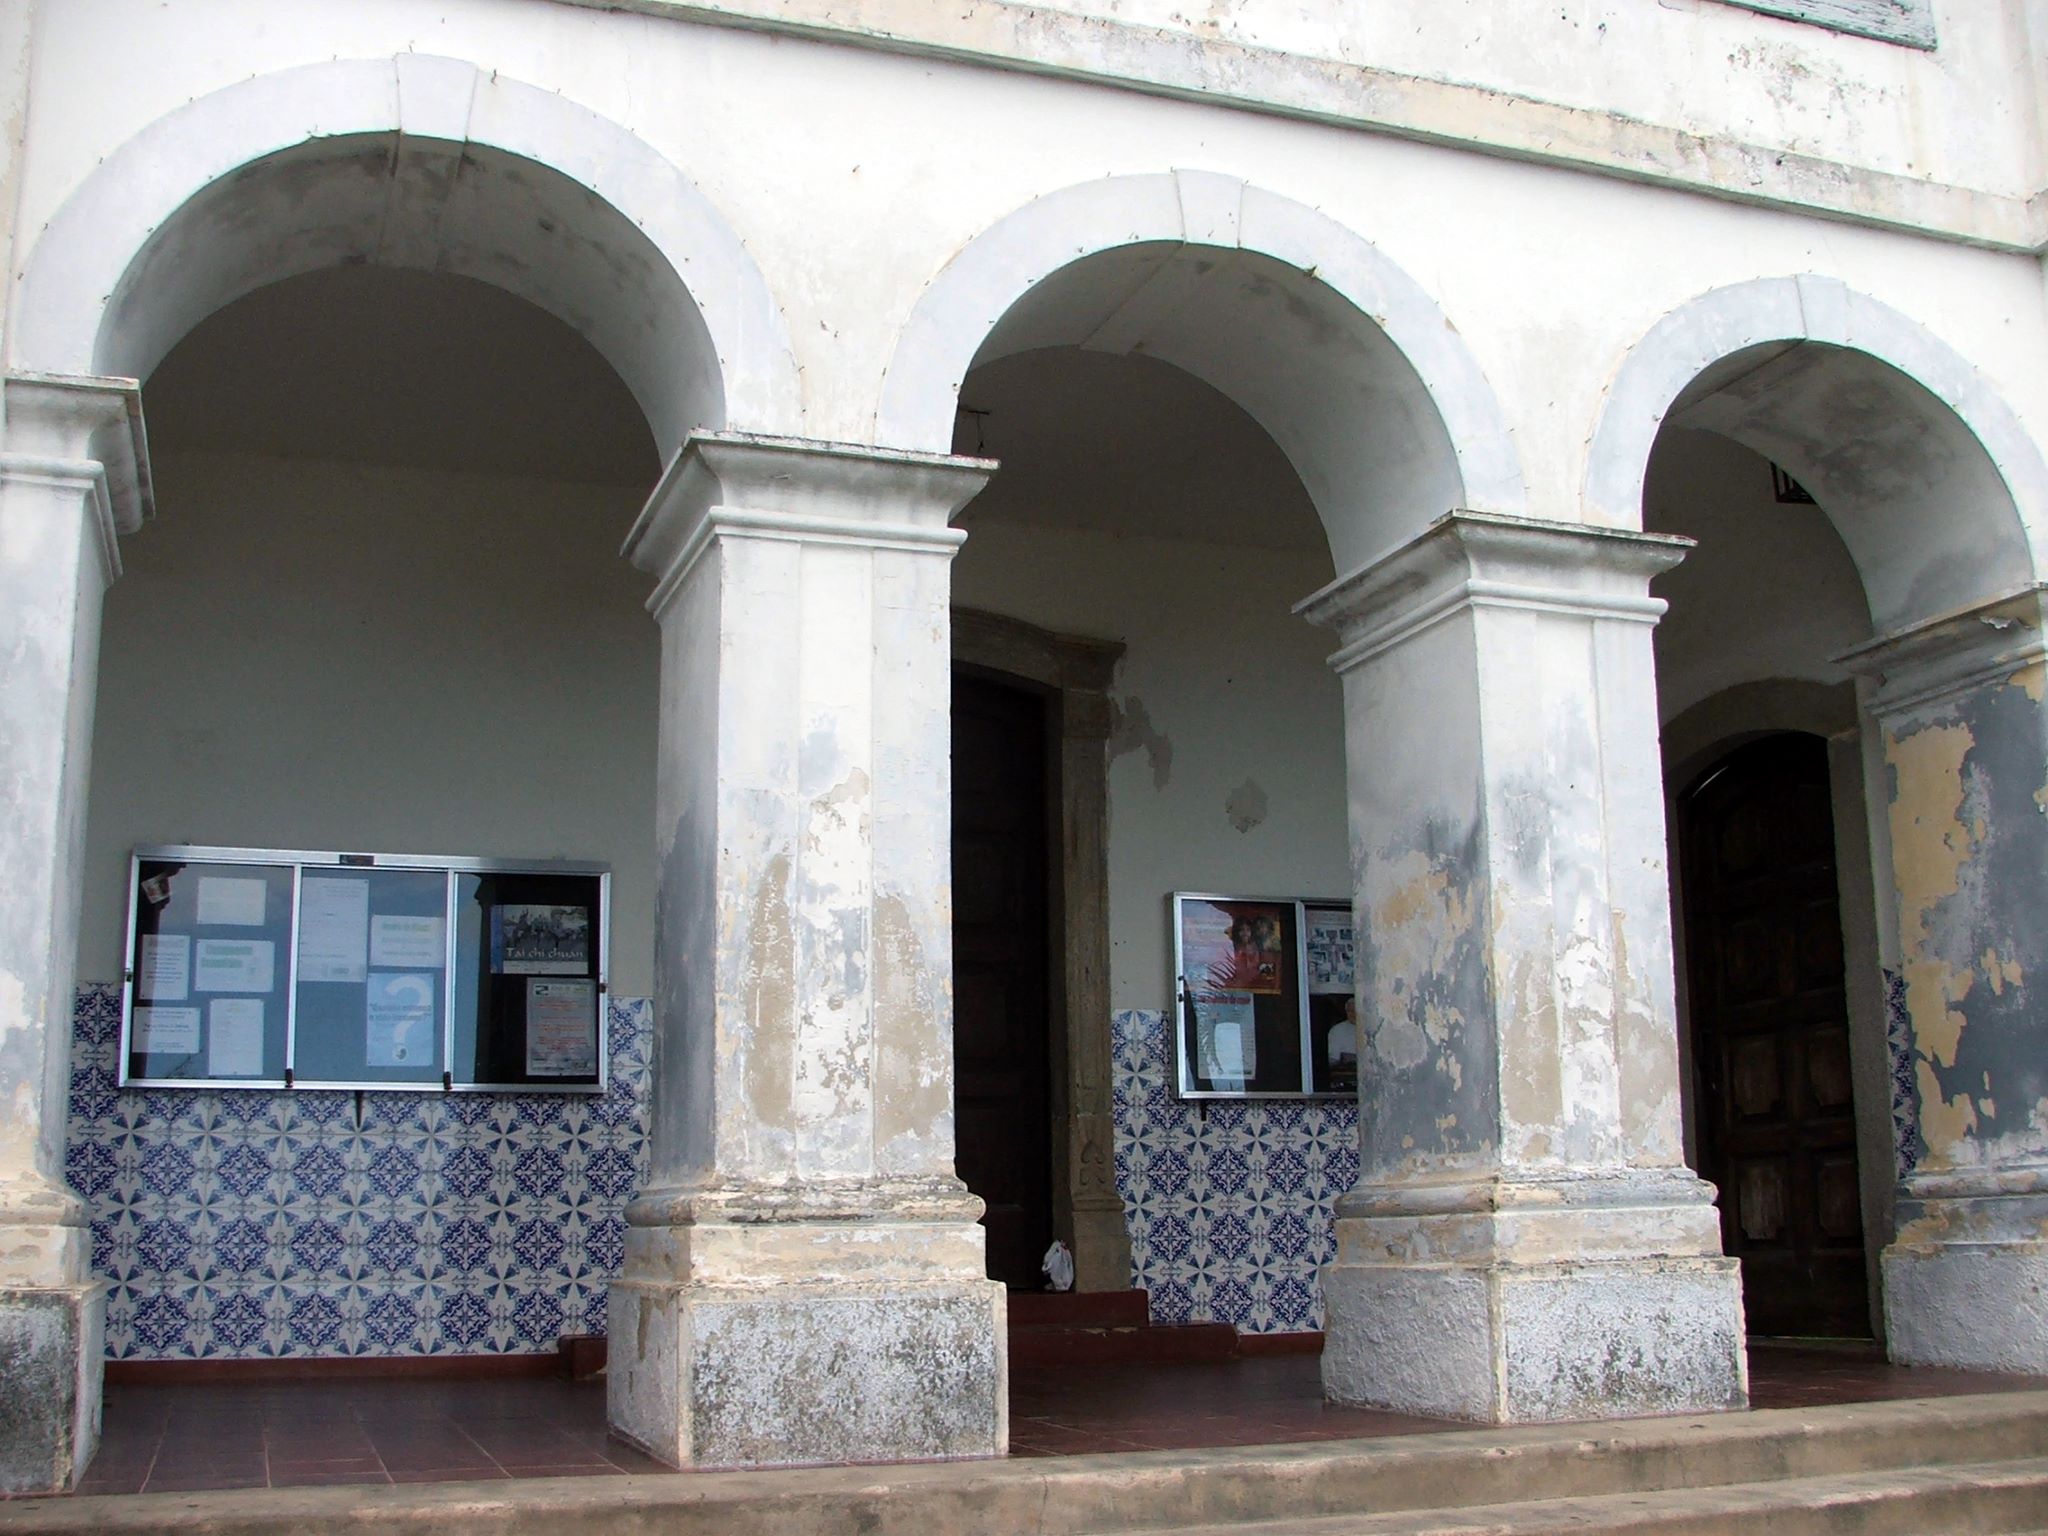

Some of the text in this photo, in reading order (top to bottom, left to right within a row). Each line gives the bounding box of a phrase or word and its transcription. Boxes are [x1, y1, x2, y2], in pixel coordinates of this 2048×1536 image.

[506, 946, 583, 958] Tai chi chuan
